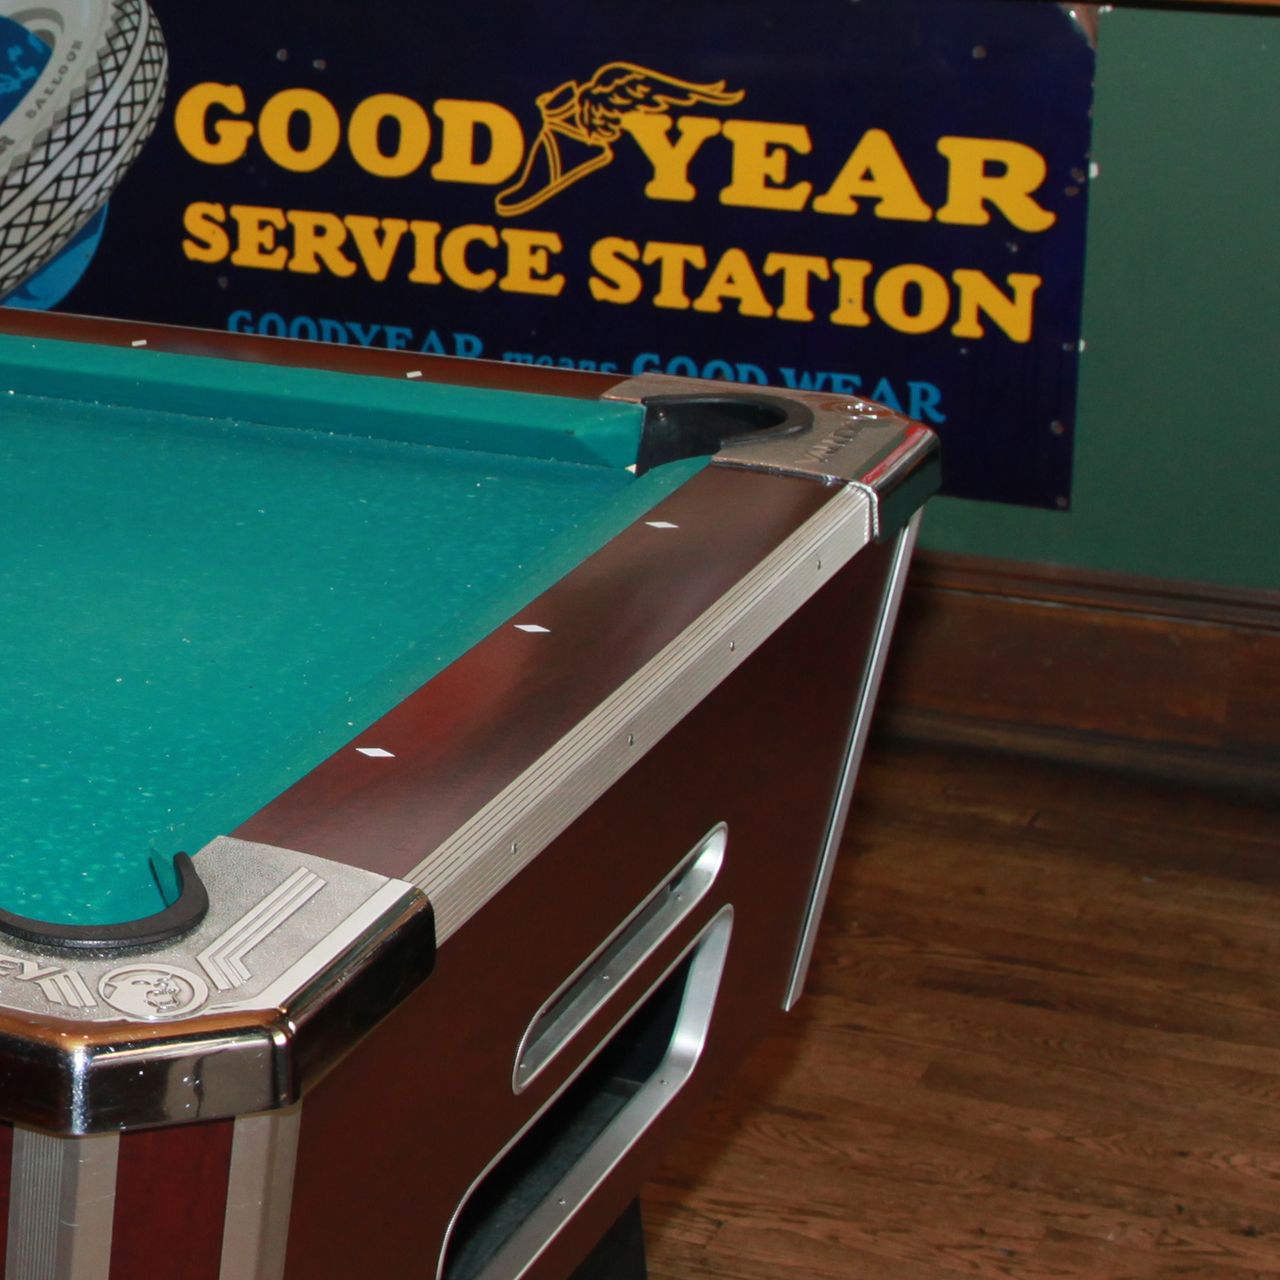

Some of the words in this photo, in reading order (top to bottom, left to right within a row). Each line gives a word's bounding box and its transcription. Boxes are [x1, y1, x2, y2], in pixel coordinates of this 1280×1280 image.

[25, 39, 84, 120] BALLOON
[174, 82, 526, 186] GOOD
[621, 112, 1057, 233] YEAR
[181, 201, 566, 297] SERVICE
[588, 235, 1043, 343] STATION
[778, 367, 948, 424] WEAR
